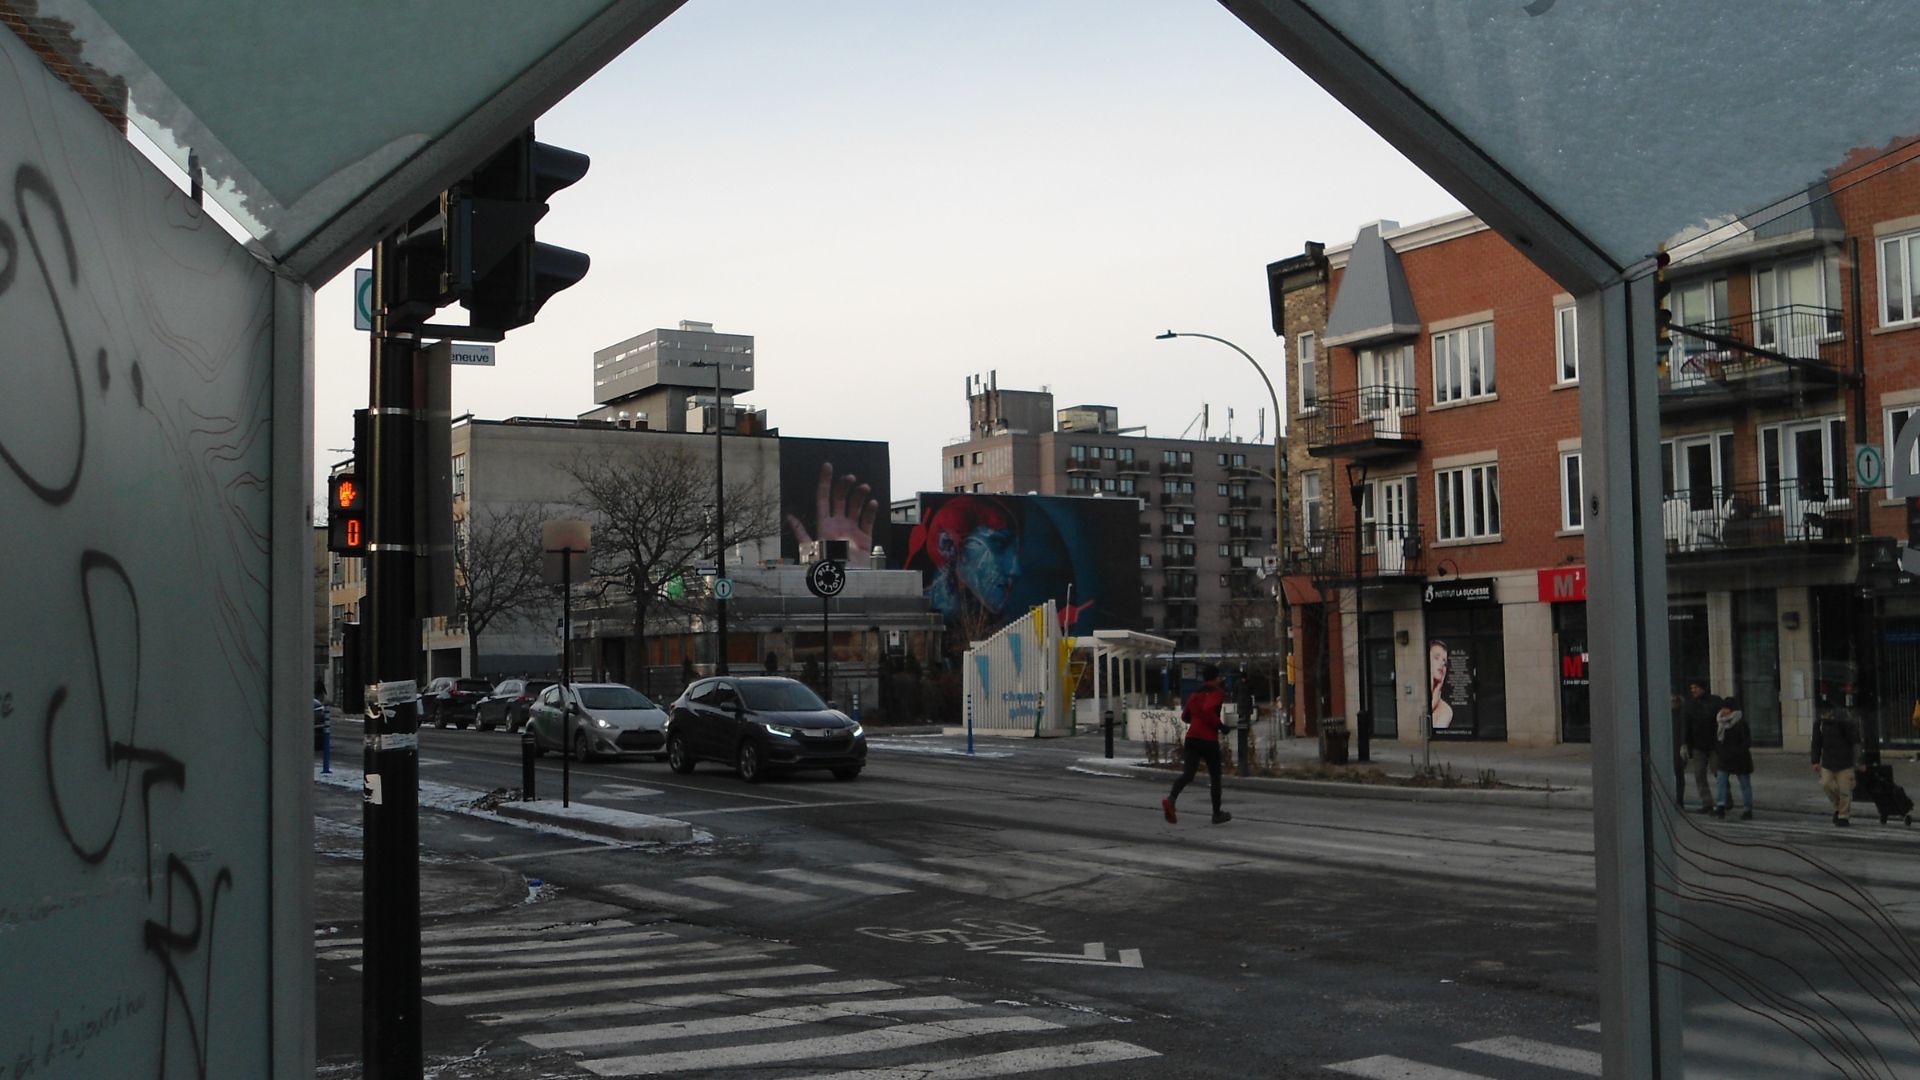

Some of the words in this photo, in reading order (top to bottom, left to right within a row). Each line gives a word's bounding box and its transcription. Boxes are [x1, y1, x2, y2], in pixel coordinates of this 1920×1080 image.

[347, 519, 359, 546] 0
[1435, 589, 1455, 598] INSTITUT
[1456, 589, 1463, 597] LA
[1463, 587, 1490, 597] DUCHESSE
